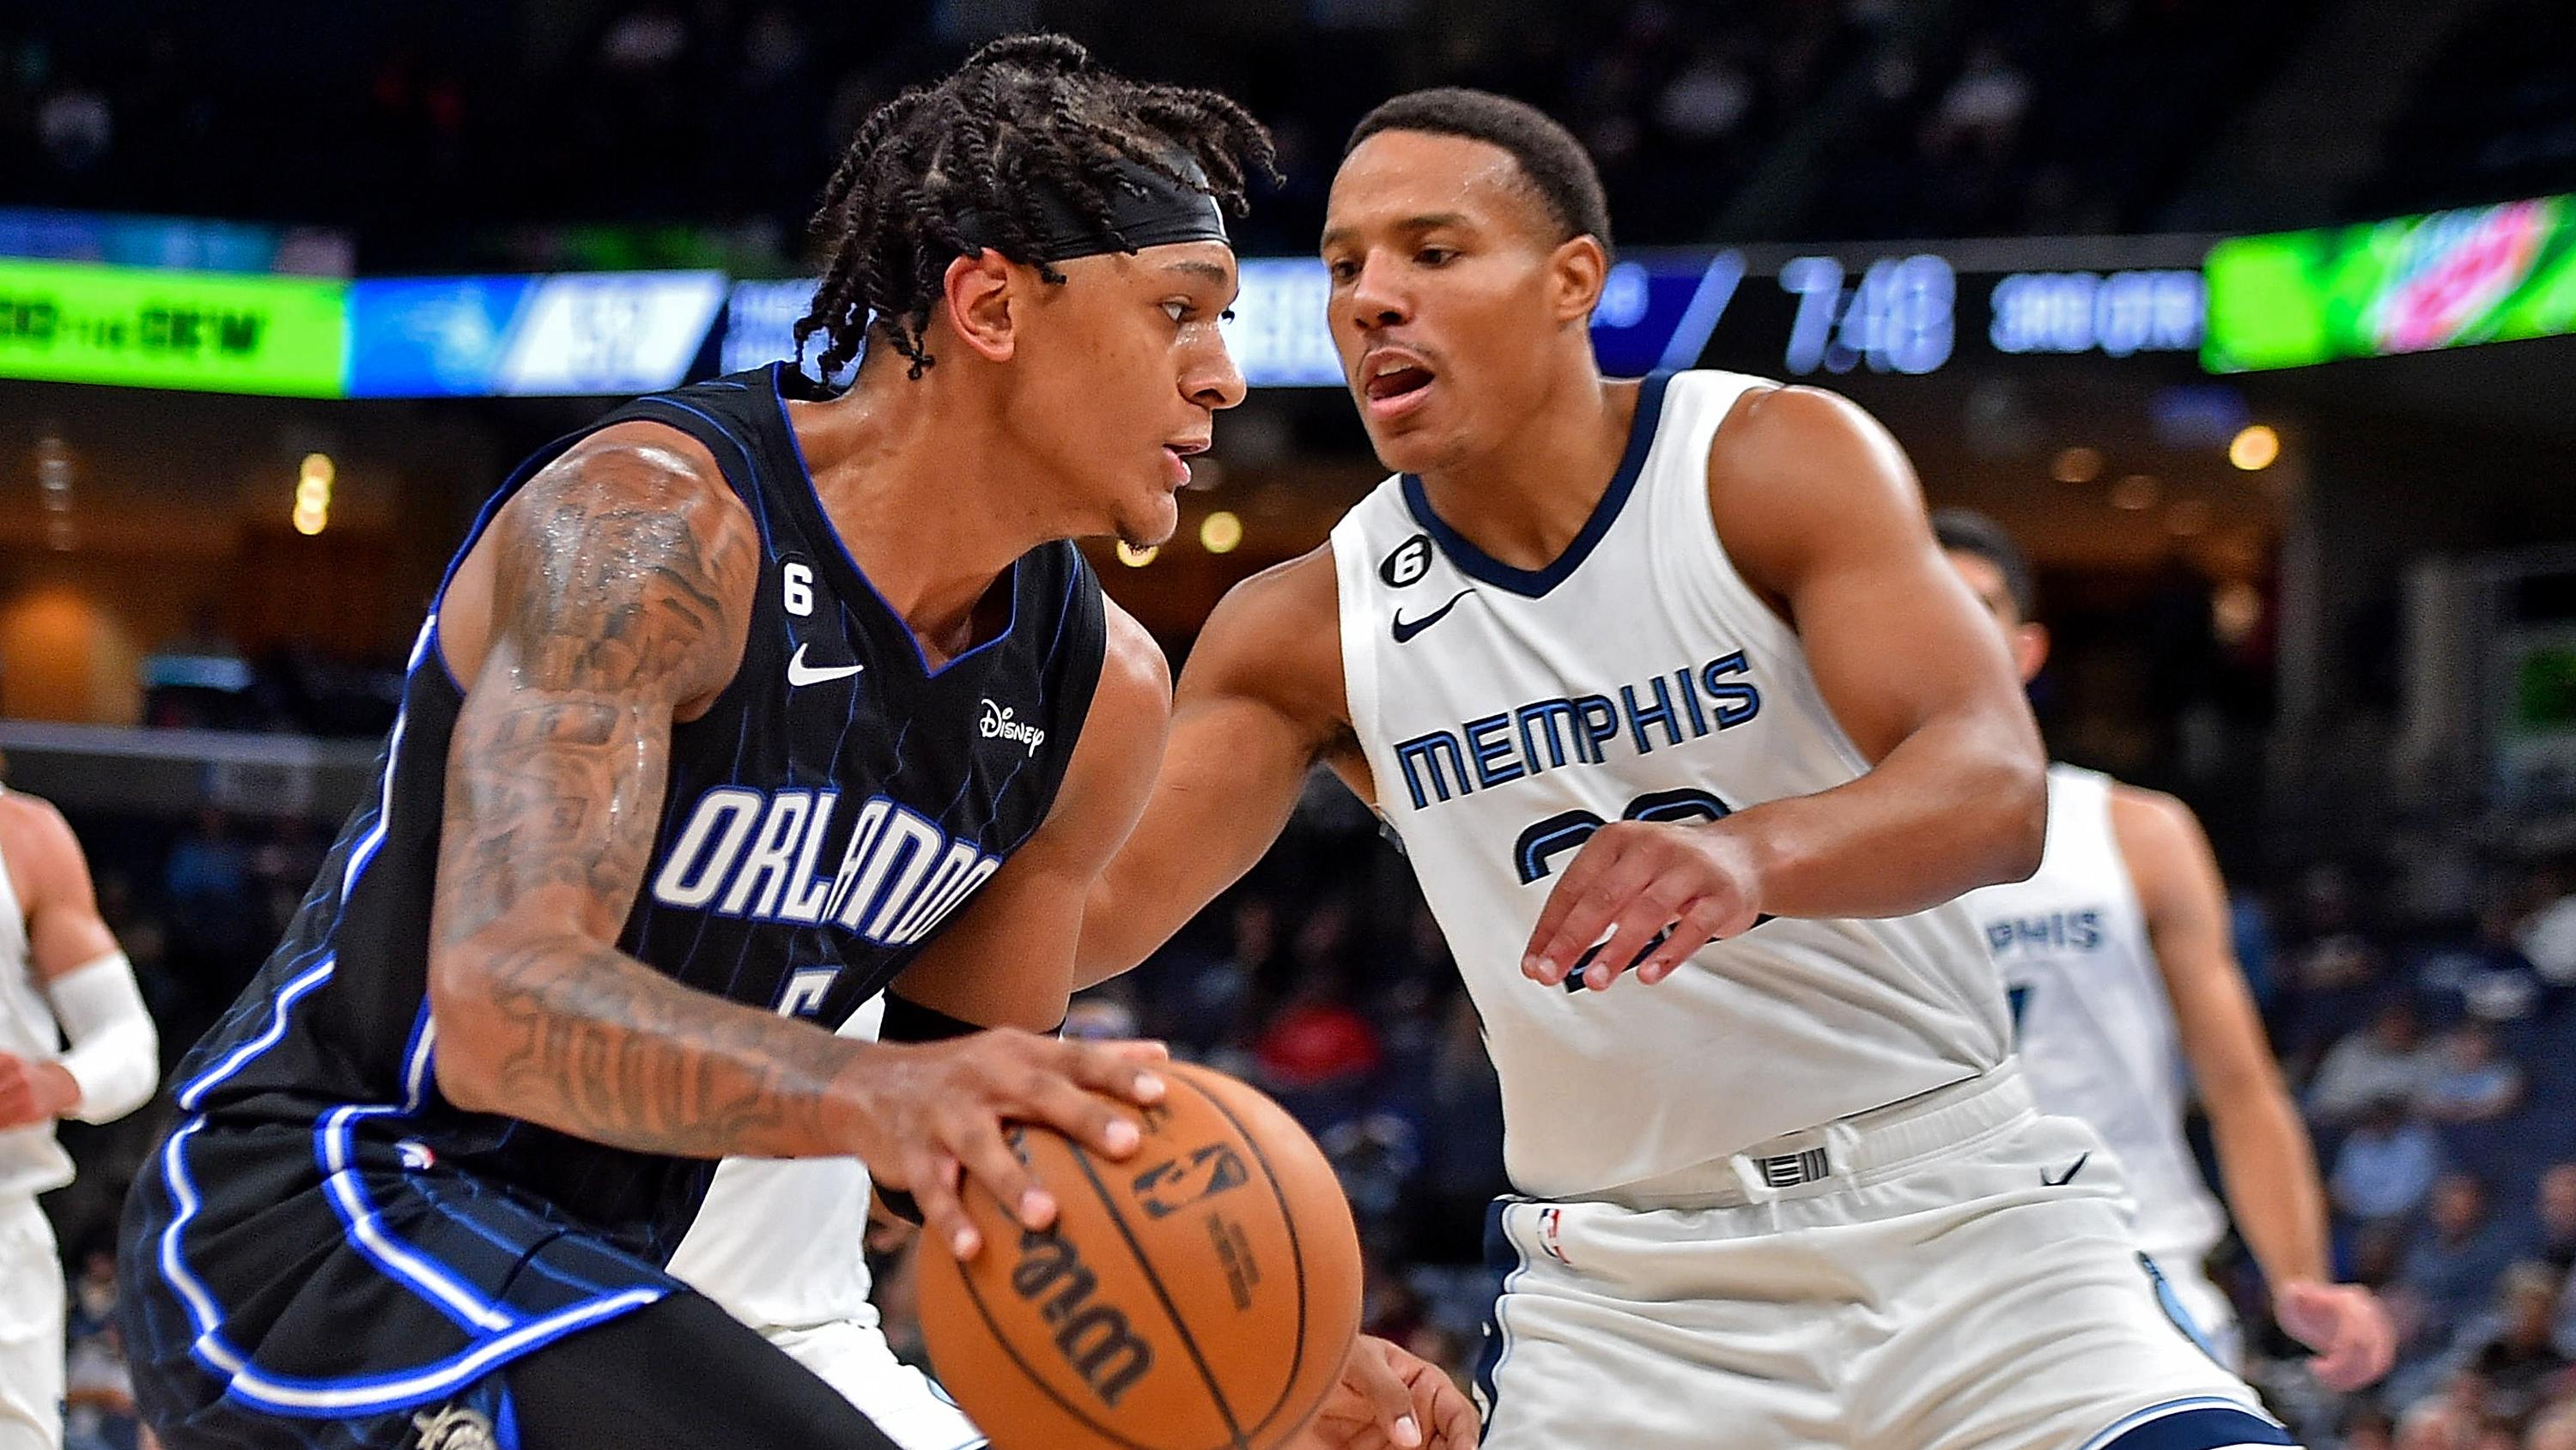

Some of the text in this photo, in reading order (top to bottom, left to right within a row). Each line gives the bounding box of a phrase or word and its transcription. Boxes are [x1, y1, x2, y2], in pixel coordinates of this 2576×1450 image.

[783, 562, 813, 616] 6
[1393, 541, 1425, 584] 6
[1393, 649, 1761, 810] MEMPHIS
[652, 785, 1002, 946] ORLANDO
[1985, 910, 2102, 950] PHIS
[1011, 1223, 1156, 1410] Wil
